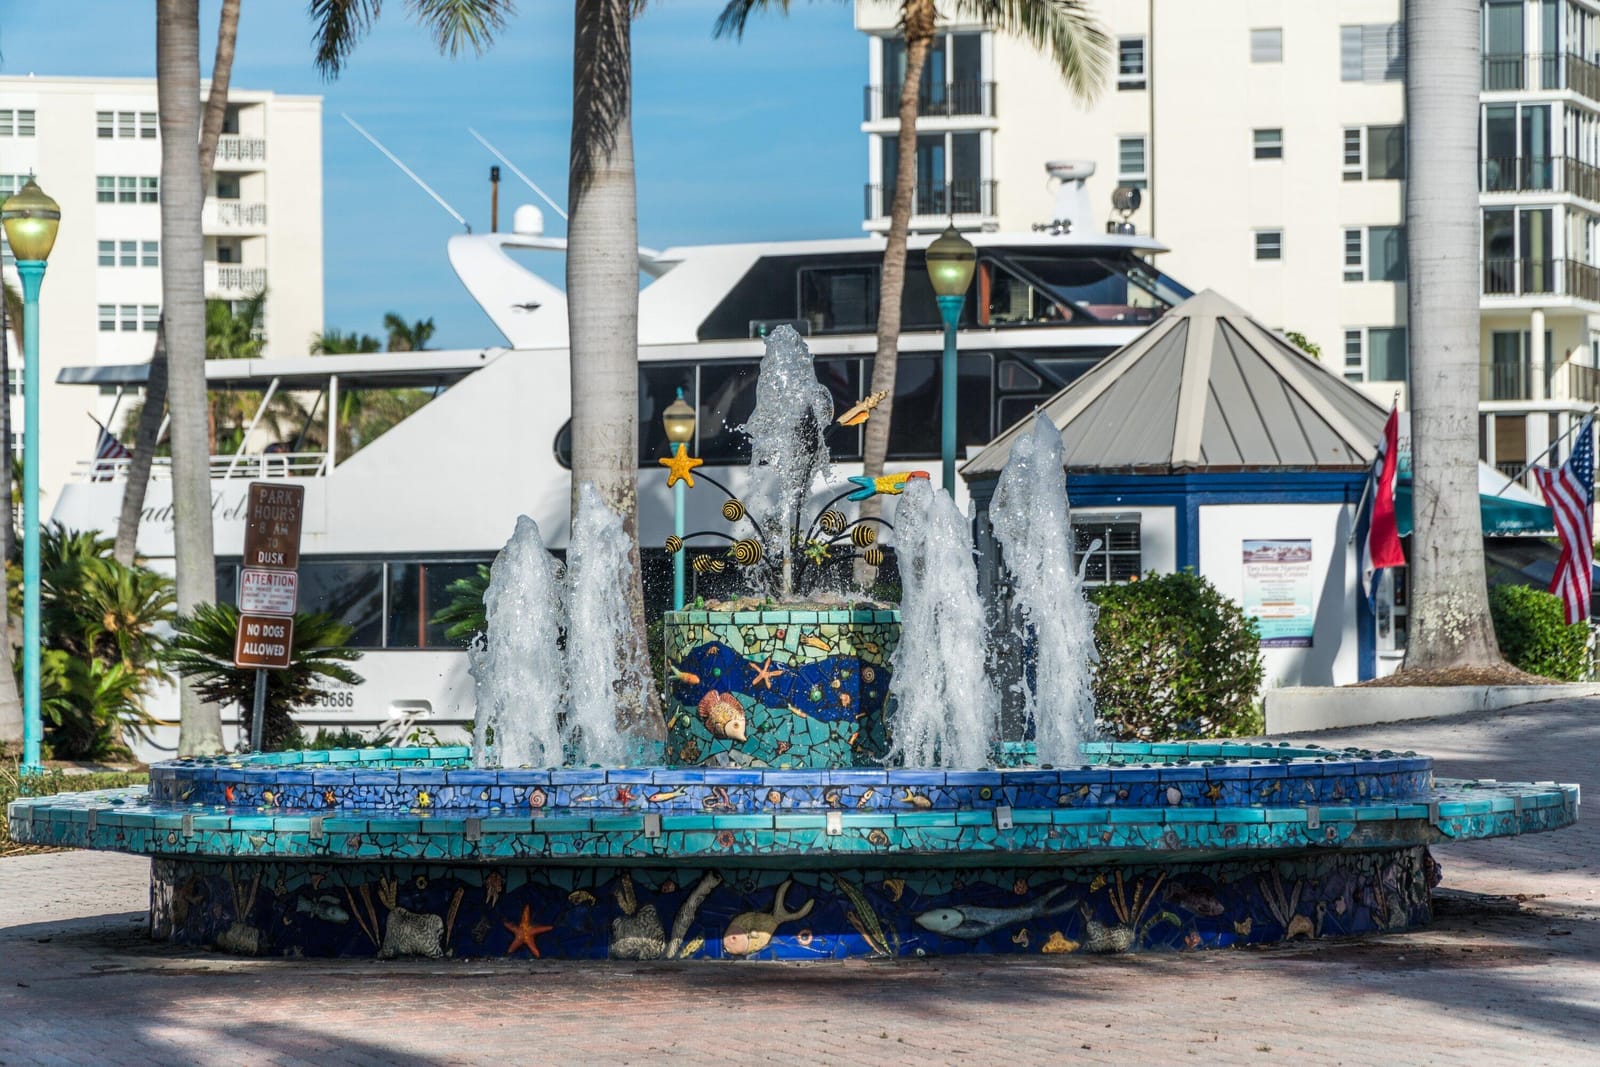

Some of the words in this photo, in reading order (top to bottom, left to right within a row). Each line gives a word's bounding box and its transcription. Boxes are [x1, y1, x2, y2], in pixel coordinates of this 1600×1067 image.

[259, 488, 293, 505] PARK
[255, 505, 295, 521] HOURS
[272, 522, 289, 536] AM
[267, 537, 279, 549] TO
[258, 551, 284, 565] DUSK
[244, 573, 295, 587] ATTENTION
[246, 623, 260, 637] NO
[262, 624, 285, 639] DOGS
[243, 642, 285, 657] ALLOWED
